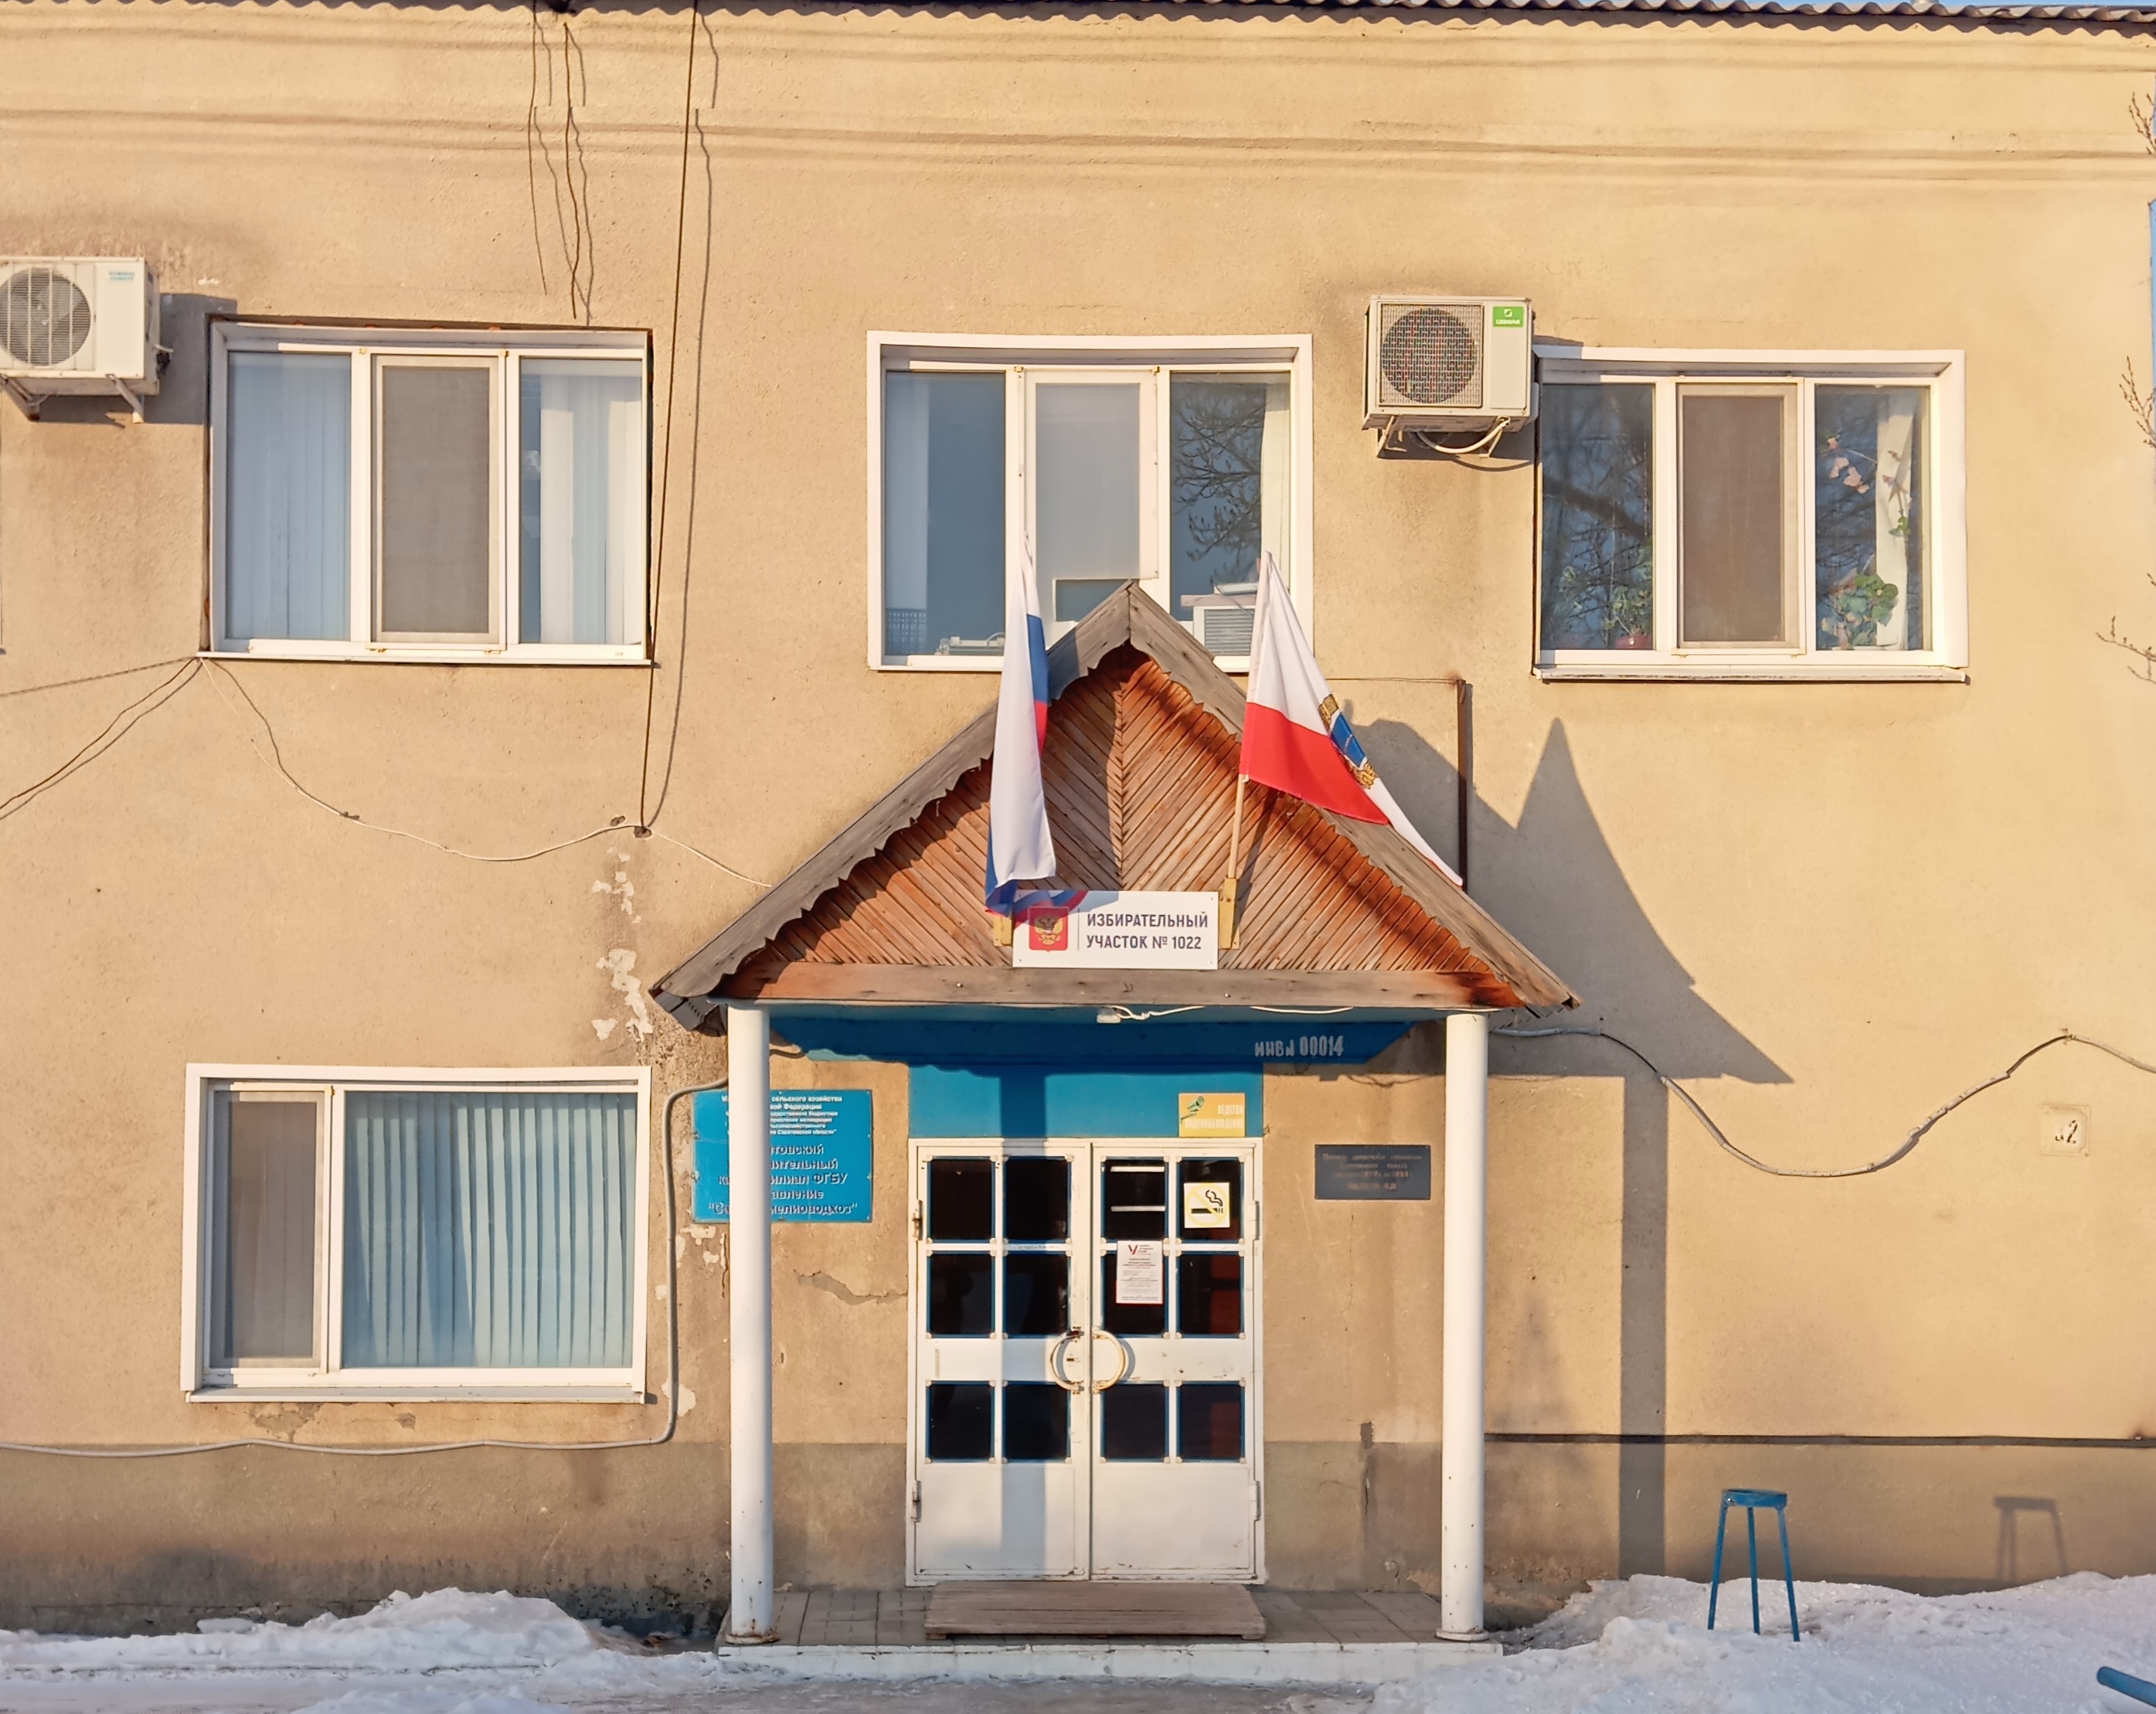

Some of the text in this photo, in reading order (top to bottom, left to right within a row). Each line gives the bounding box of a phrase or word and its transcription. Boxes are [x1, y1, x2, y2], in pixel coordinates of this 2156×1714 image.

[1087, 911, 1208, 928] ИЗБИРАТЕЛЬНЫЙ
[1087, 935, 1202, 950] УЧАСТОК № 1022
[1299, 1035, 1344, 1056] 00014
[770, 1172, 848, 1185] илиал ФГБУ
